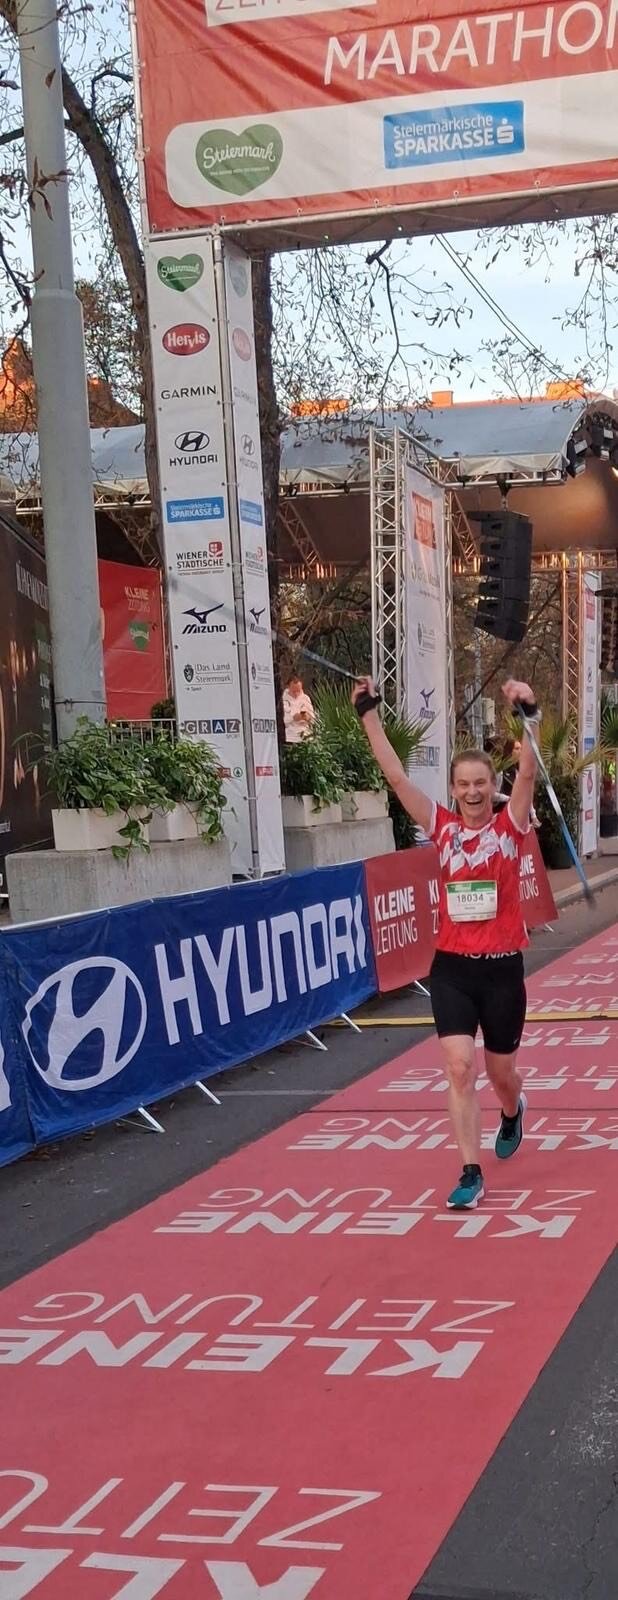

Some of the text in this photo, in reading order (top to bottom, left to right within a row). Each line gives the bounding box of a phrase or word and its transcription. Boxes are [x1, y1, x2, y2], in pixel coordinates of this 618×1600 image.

[203, 142, 276, 169] Steiermark
[394, 128, 495, 158] SPARKASSE
[167, 329, 206, 348] Hervis
[161, 385, 217, 400] GARMIN
[169, 455, 218, 467] HYUNDAI
[176, 551, 208, 560] WIENER
[185, 720, 239, 733] GRAZ
[374, 886, 416, 923] KLEINE
[457, 893, 484, 903] 18034
[375, 916, 418, 956] ZEITUNG
[154, 895, 366, 1046] HYUNDAI
[197, 1187, 597, 1211] ZETUNG
[153, 1211, 578, 1239] KLEINE
[18, 1291, 516, 1334] ZEITUNG
[0, 1328, 485, 1379] KLEINE
